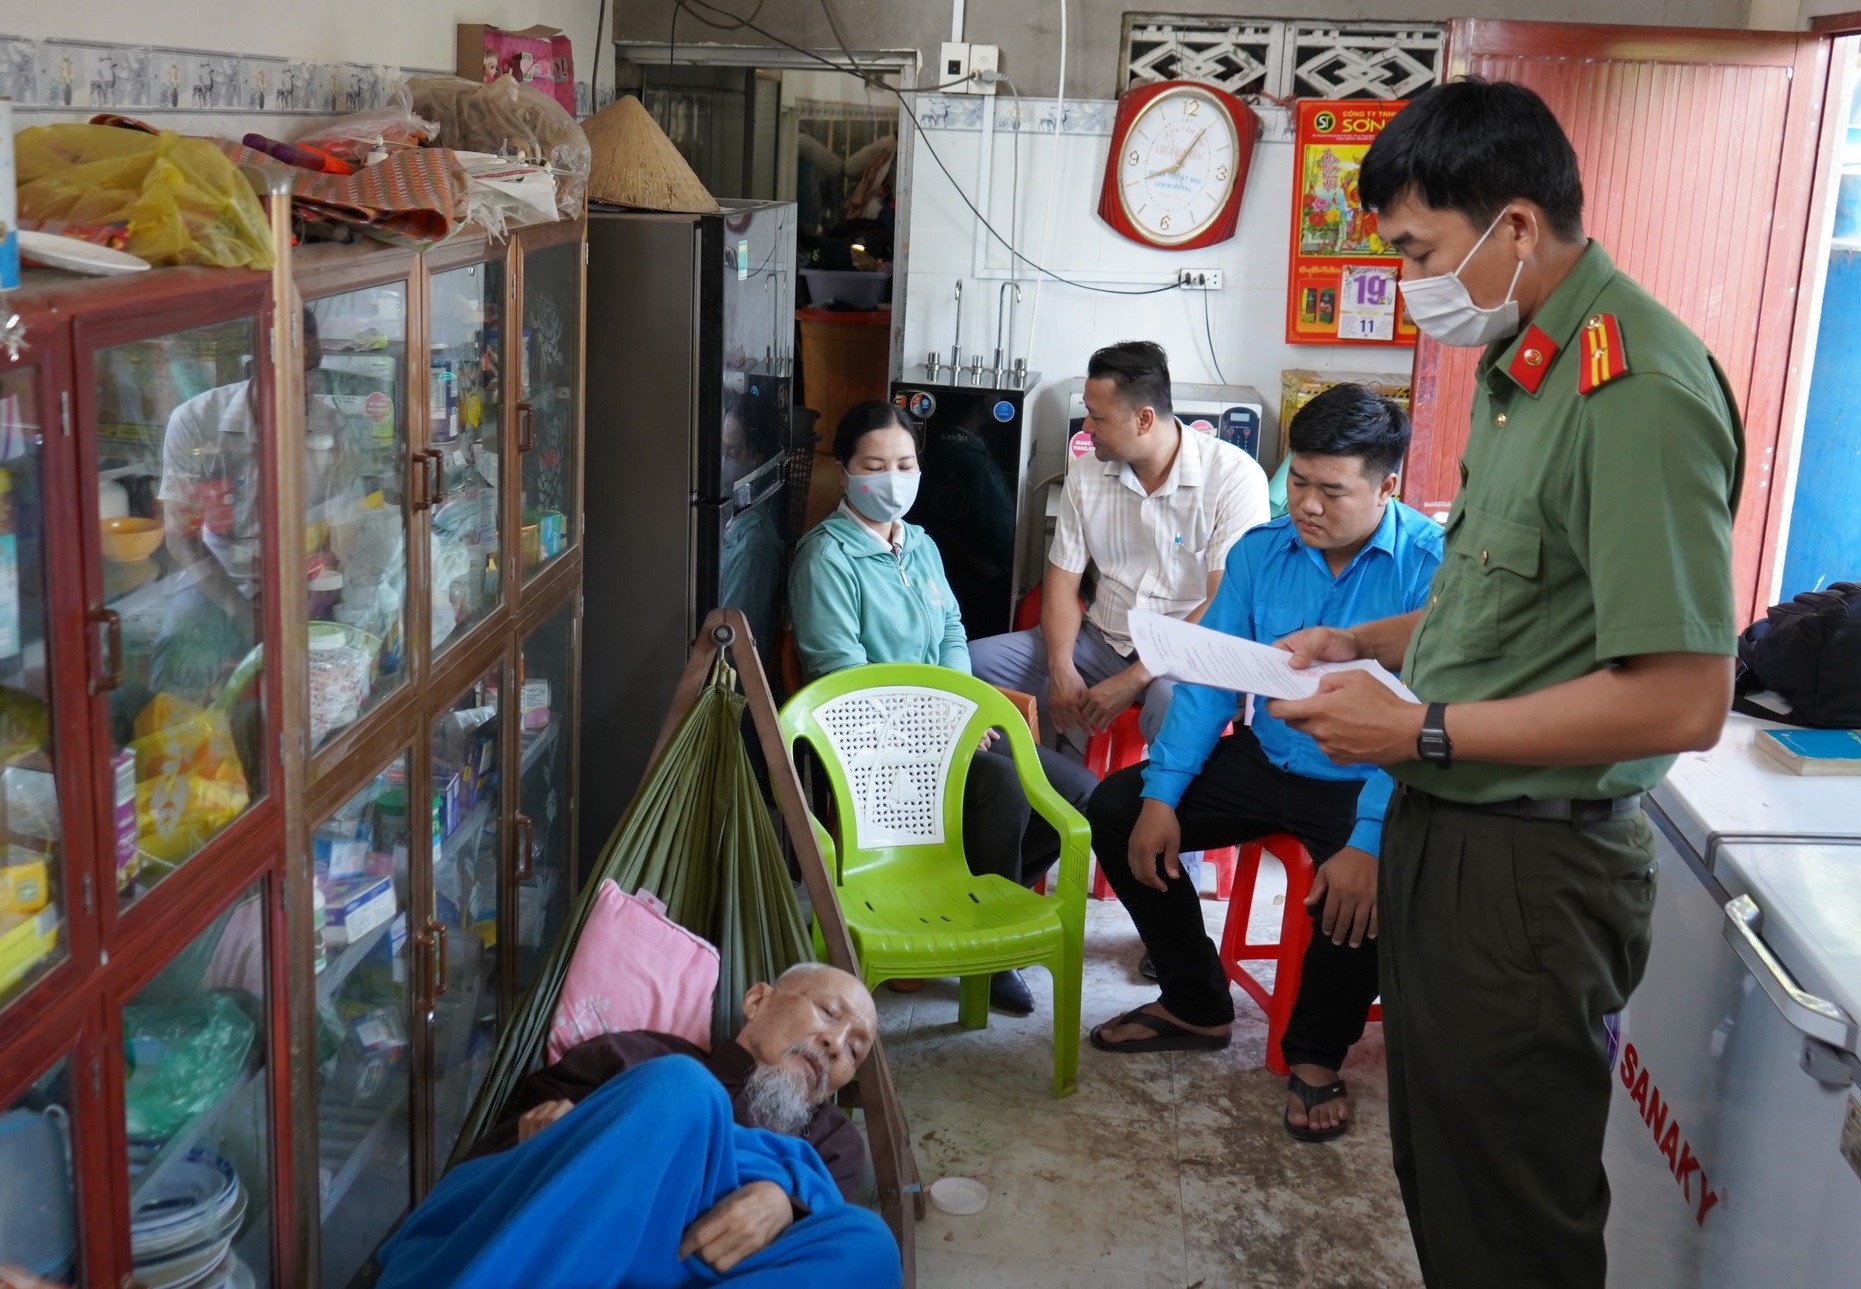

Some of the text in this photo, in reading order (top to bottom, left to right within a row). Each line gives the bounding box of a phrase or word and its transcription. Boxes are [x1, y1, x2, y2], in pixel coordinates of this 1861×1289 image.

[1182, 99, 1200, 117] 12
[1129, 150, 1140, 166] 9
[1216, 165, 1228, 181] 3
[1160, 215, 1171, 231] 6
[1353, 274, 1387, 305] 19
[1360, 319, 1375, 333] 11
[1619, 1042, 1719, 1228] SANAKY
